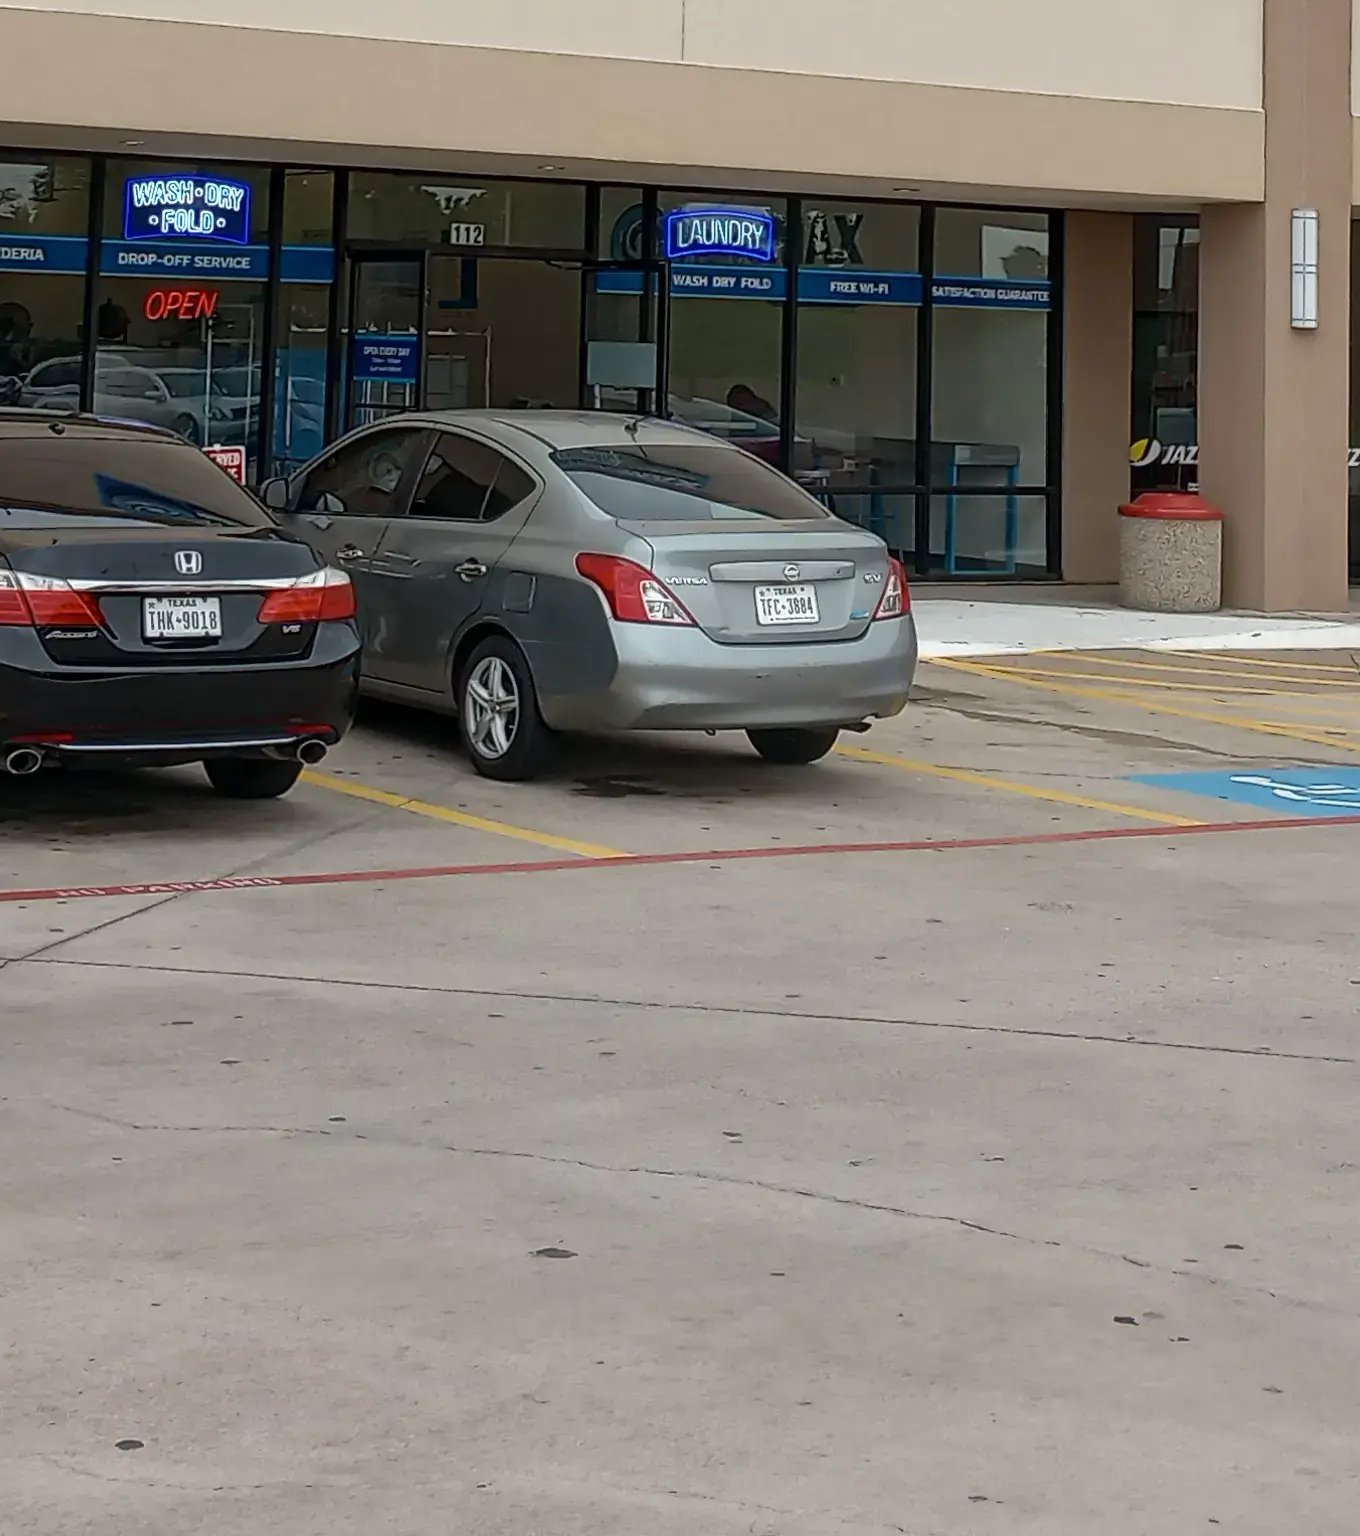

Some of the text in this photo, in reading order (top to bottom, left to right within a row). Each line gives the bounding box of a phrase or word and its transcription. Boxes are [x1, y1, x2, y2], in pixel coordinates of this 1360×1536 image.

[133, 180, 244, 212] WASH DRY
[161, 209, 214, 234] FOLD
[453, 225, 482, 244] 112
[677, 218, 764, 249] LAUNDRY
[117, 252, 251, 269] DROP-OFF SERVICE
[673, 275, 771, 289] WASH DRY FOLD
[830, 281, 889, 295] FREE WI-FI
[931, 286, 995, 298] SATISFACTION
[145, 291, 218, 320] OPEN
[168, 598, 197, 607] TEXAS
